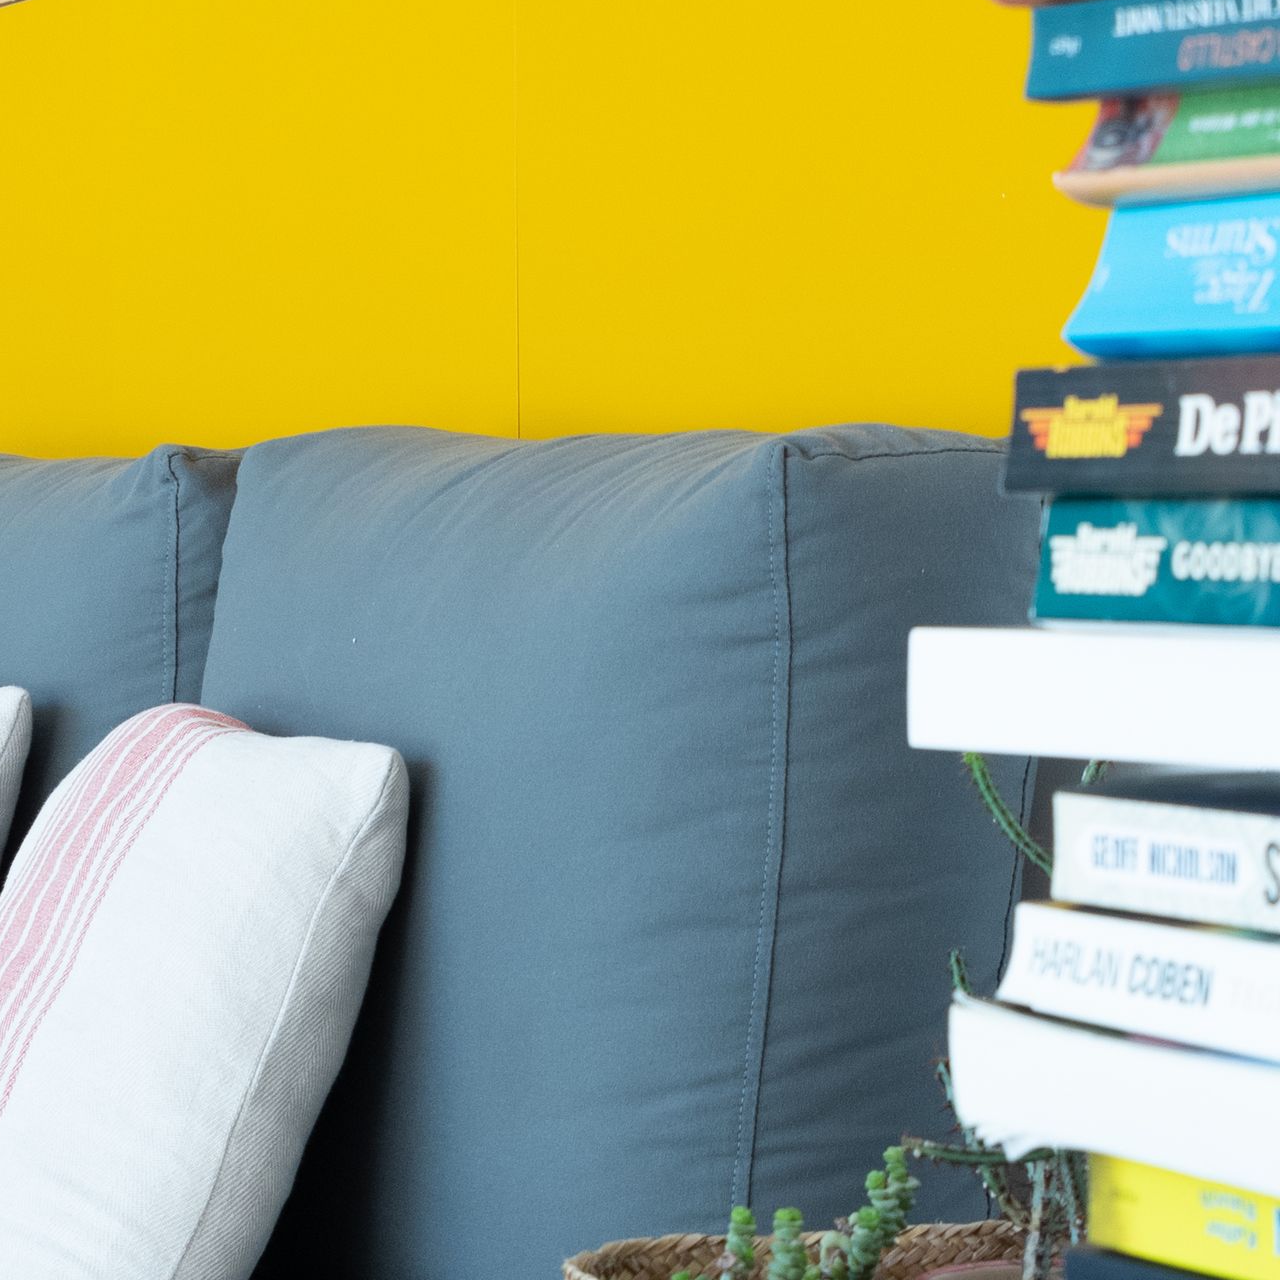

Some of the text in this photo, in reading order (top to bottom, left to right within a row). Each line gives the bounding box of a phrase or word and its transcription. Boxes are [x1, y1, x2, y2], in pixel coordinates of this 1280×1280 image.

[1175, 393, 1240, 457] De
[1148, 836, 1240, 886] NICHOLSON
[1028, 937, 1121, 989] HARLAN
[1128, 953, 1217, 1007] COBEN
